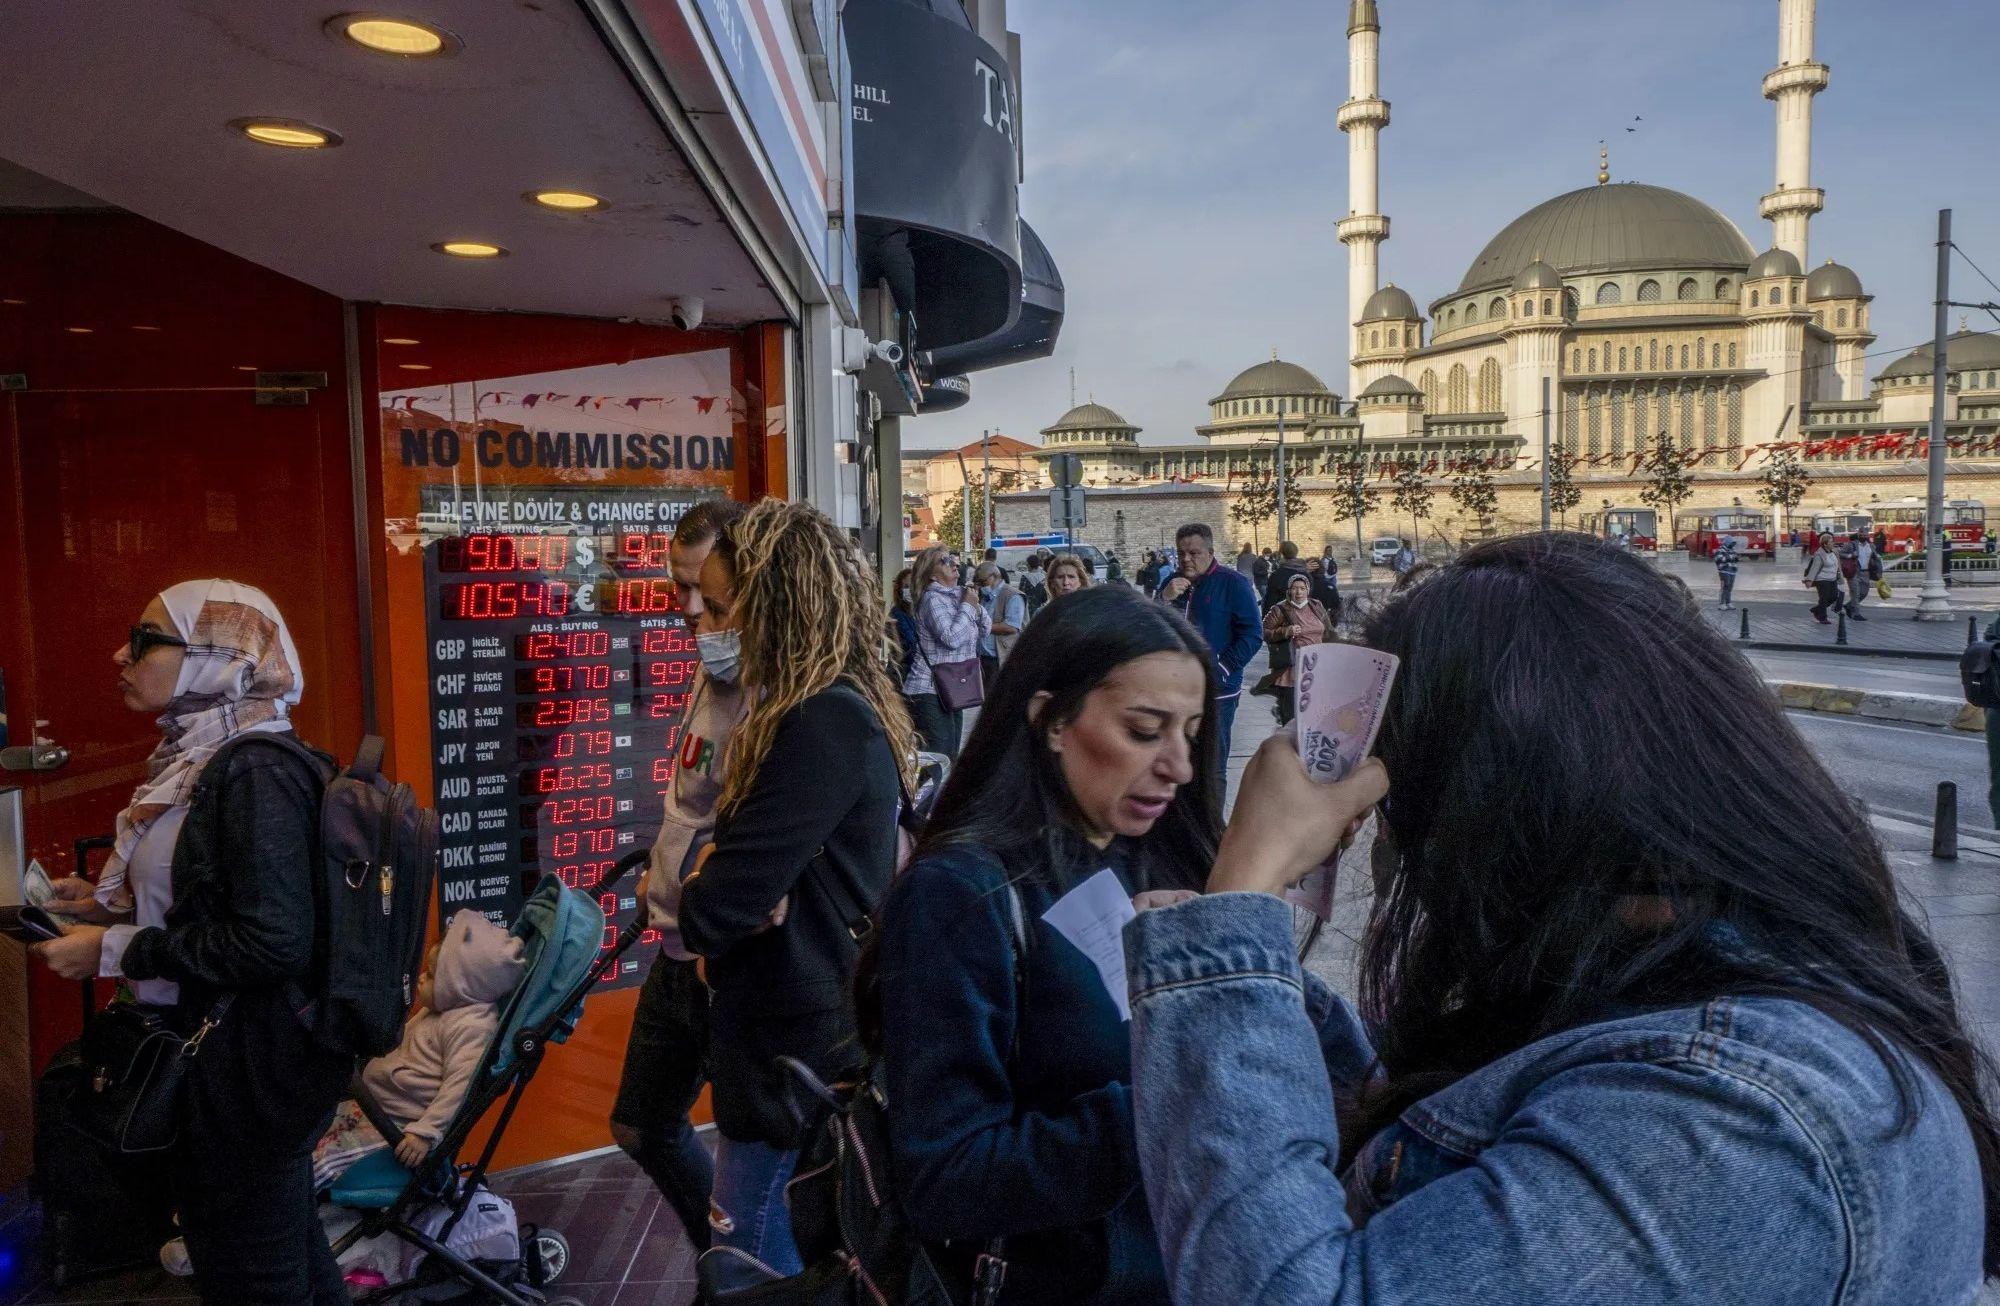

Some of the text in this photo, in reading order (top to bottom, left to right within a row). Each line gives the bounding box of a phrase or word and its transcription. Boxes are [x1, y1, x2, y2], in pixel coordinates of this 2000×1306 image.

[854, 84, 890, 104] HILL
[975, 57, 1016, 144] TA
[853, 106, 872, 122] EL
[402, 429, 734, 470] NO COMMISSION
[440, 497, 693, 520] PLEVNE DÖVİZ & CHANGE OFF
[622, 524, 649, 534] SATIŞ
[624, 534, 668, 568] 9.2
[530, 624, 553, 633] ALIŞ
[561, 621, 599, 631] BUYING
[640, 619, 667, 628] SATIŞ
[436, 639, 466, 660] GBP
[437, 673, 466, 695] CHF
[1299, 652, 1318, 713] 200
[438, 708, 468, 730] SAR
[483, 706, 503, 716] ARAB
[439, 743, 467, 765] JPY
[475, 741, 500, 750] JAPON
[1316, 735, 1340, 772] 200
[475, 751, 494, 761] YENİ
[440, 777, 471, 798] AUD
[477, 785, 504, 796] DOLARI
[442, 811, 472, 833] CAD
[478, 808, 508, 819] KANADA
[478, 819, 505, 830] DOLARI
[443, 845, 474, 868] DKK
[479, 853, 506, 864] KRONU
[444, 879, 476, 902] NOK
[480, 875, 510, 887] NORVEÇ
[480, 886, 507, 898] KRONU
